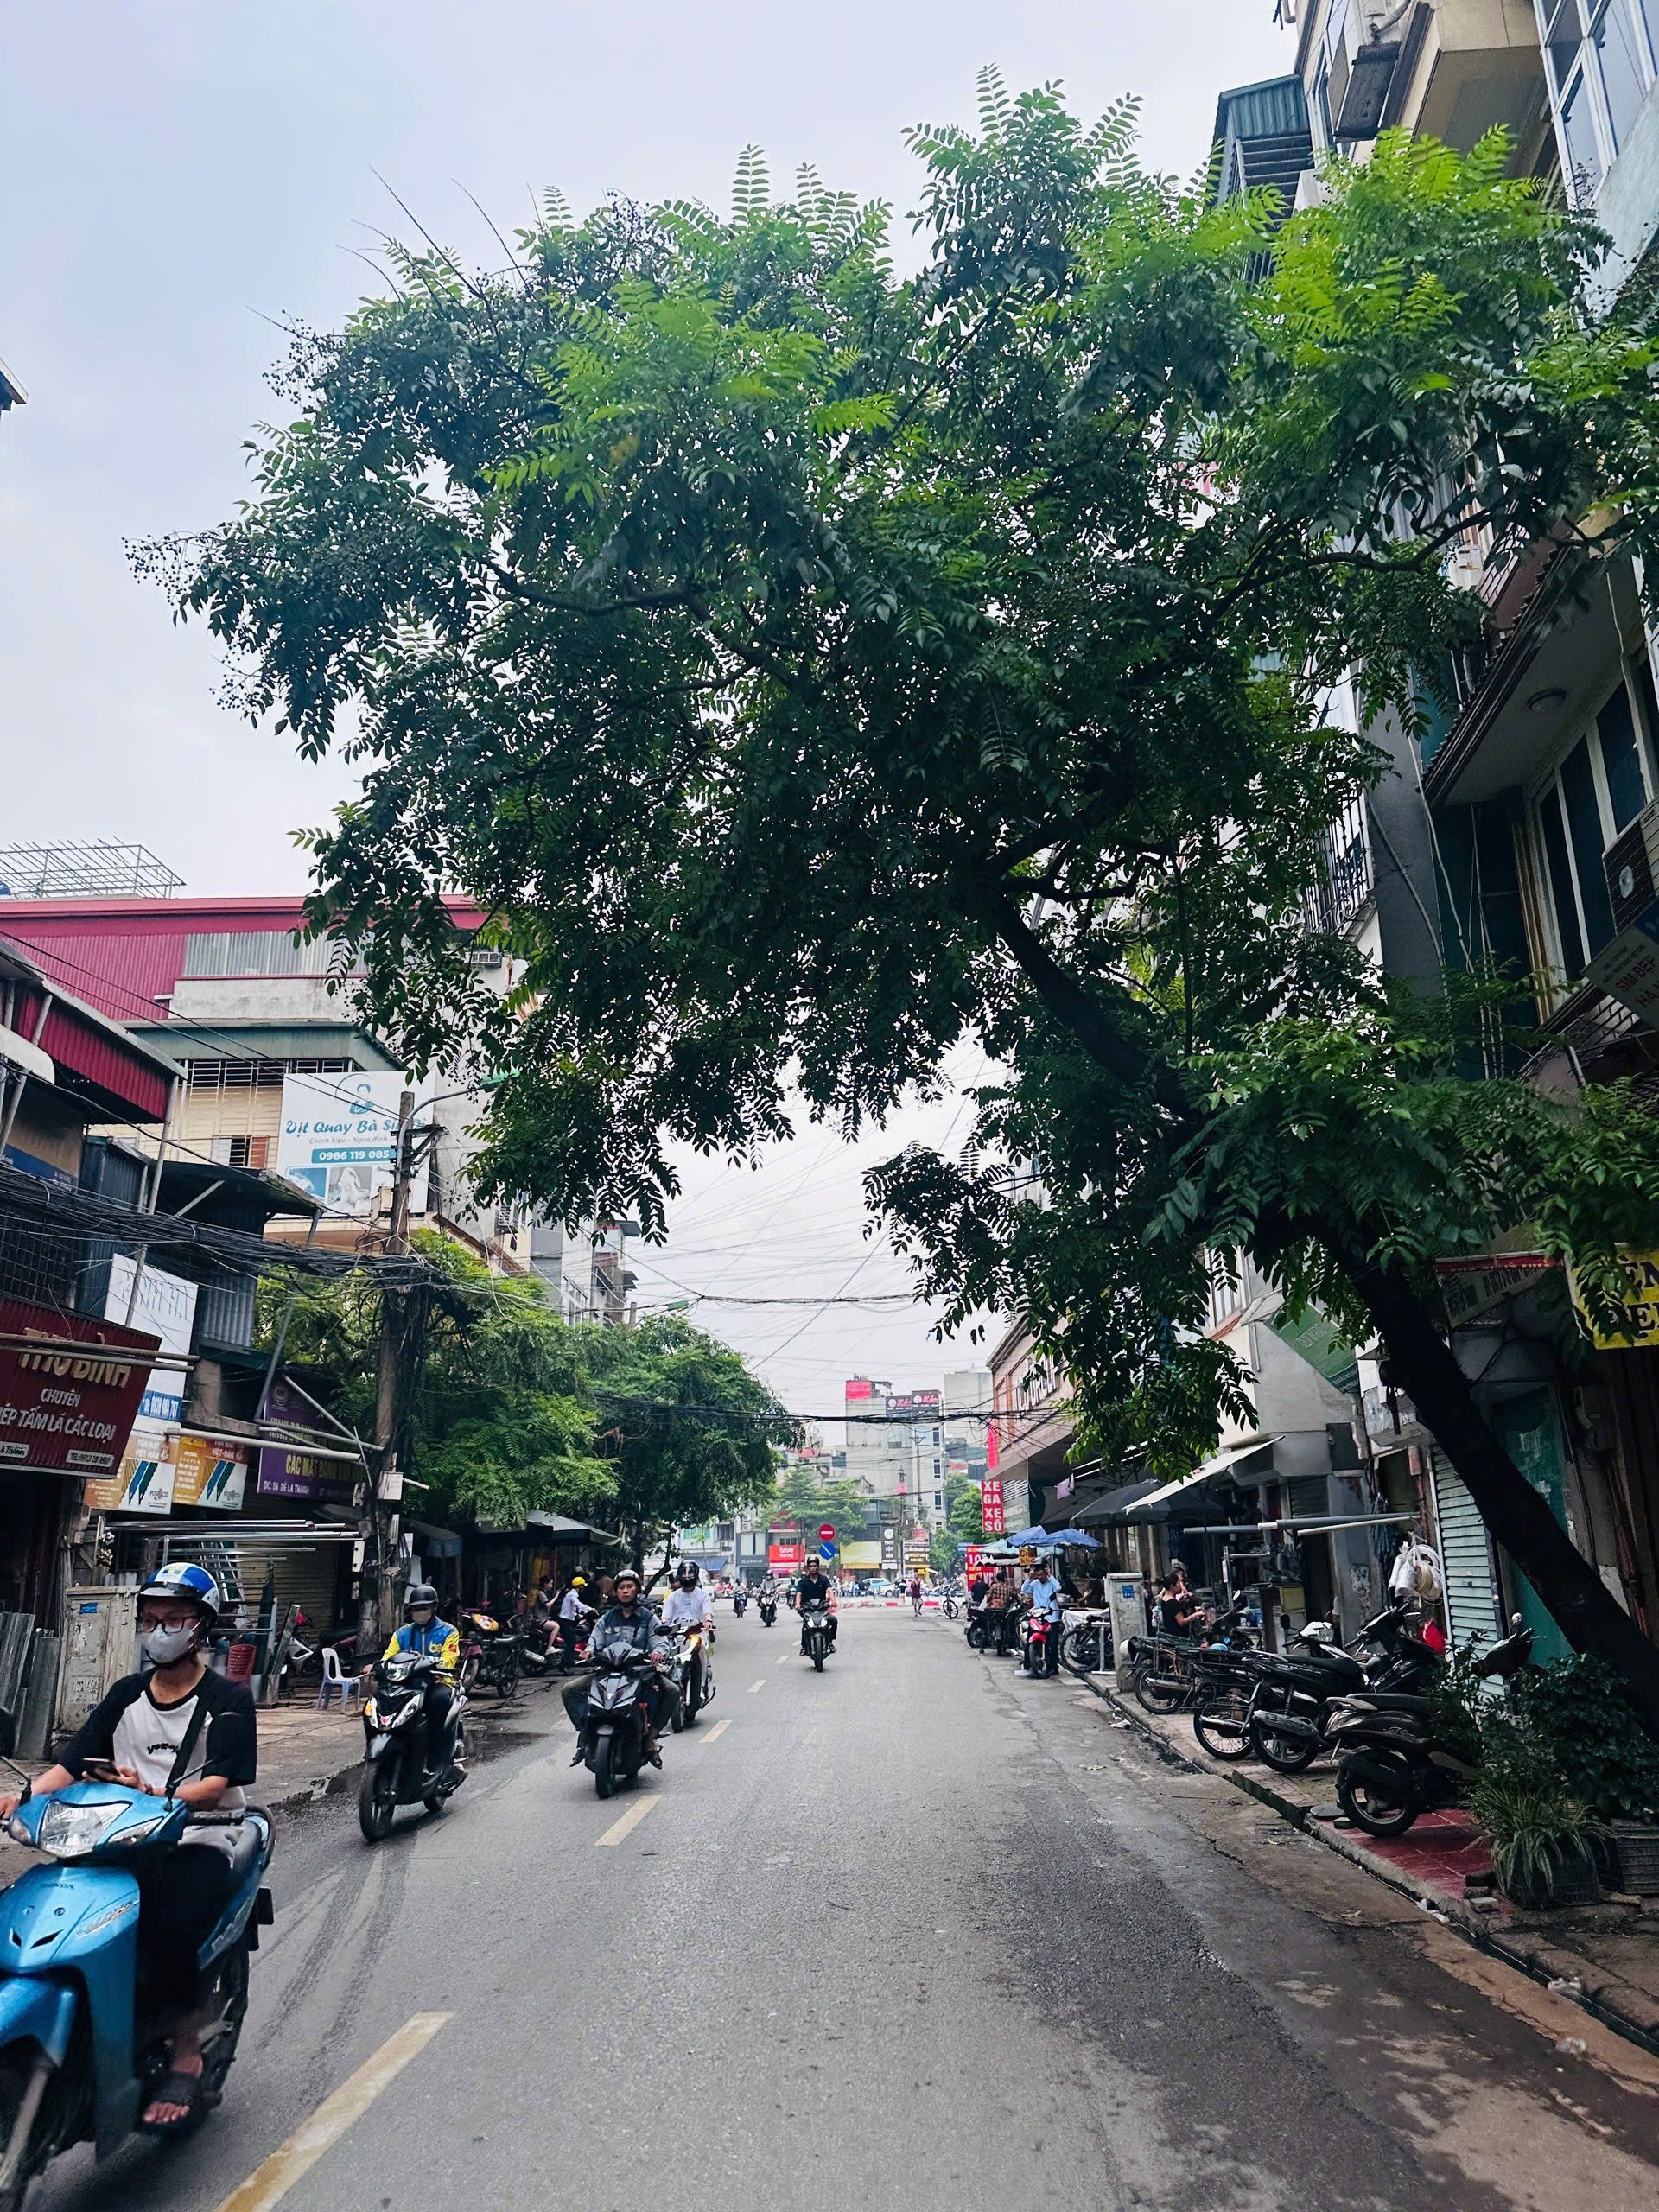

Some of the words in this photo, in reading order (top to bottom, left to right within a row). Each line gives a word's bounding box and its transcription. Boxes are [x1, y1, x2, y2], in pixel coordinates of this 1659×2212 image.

[285, 1120, 309, 1138] Vịt
[313, 1121, 352, 1135] Quay
[357, 1119, 378, 1134] Bà
[319, 1151, 347, 1161] 0986
[350, 1150, 366, 1160] 119
[369, 1149, 390, 1160] 085
[41, 1389, 80, 1407] CHUYÊN
[0, 1402, 18, 1426] ÉP
[19, 1407, 46, 1430] TẤM
[46, 1413, 66, 1434] LÁ
[65, 1414, 89, 1437] CÁC
[88, 1423, 116, 1443] LOẠI
[983, 1481, 1000, 1491] XE
[983, 1494, 1001, 1504] GA
